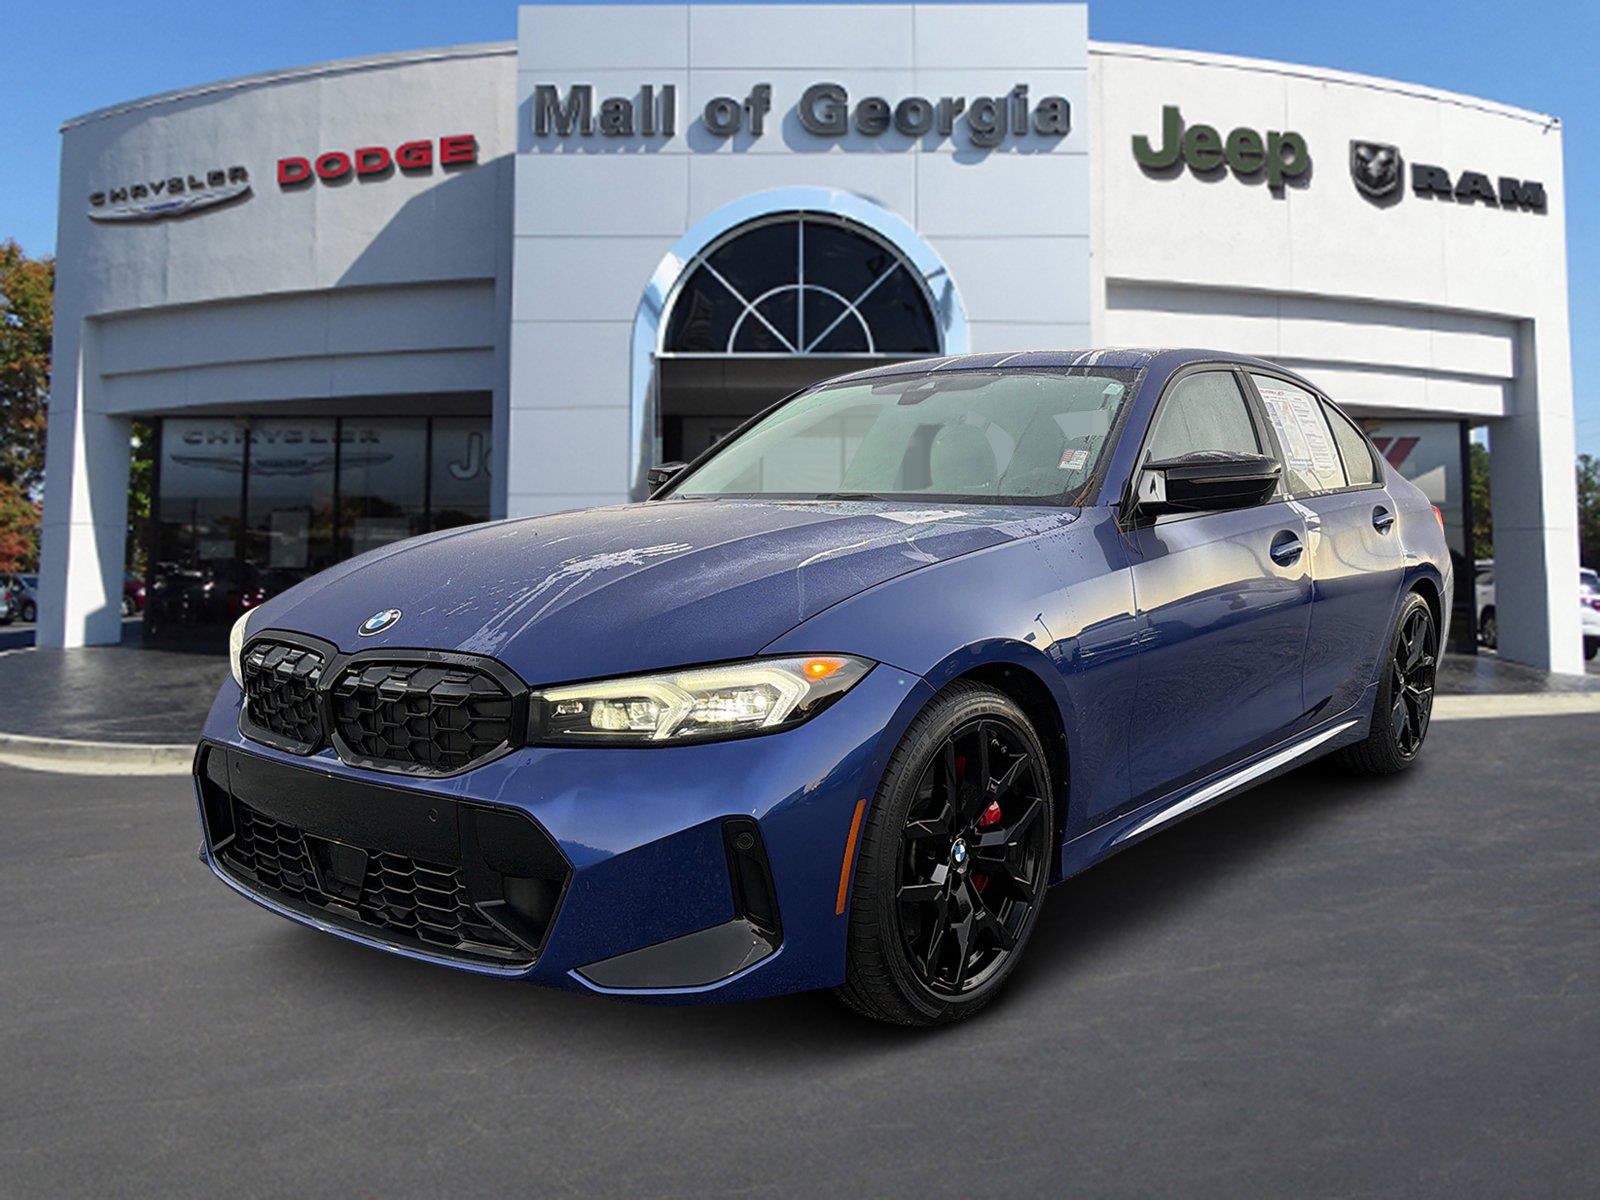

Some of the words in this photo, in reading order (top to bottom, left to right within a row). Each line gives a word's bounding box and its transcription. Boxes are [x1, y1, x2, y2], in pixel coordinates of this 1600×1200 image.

[533, 84, 677, 137] Mall
[704, 84, 772, 137] of
[800, 83, 1072, 147] Georgia
[277, 134, 478, 189] DODGE
[1131, 105, 1310, 192] Jeep
[89, 165, 249, 207] CHRYSLER
[1411, 163, 1547, 213] RAM
[183, 430, 381, 445] CHRYSLER
